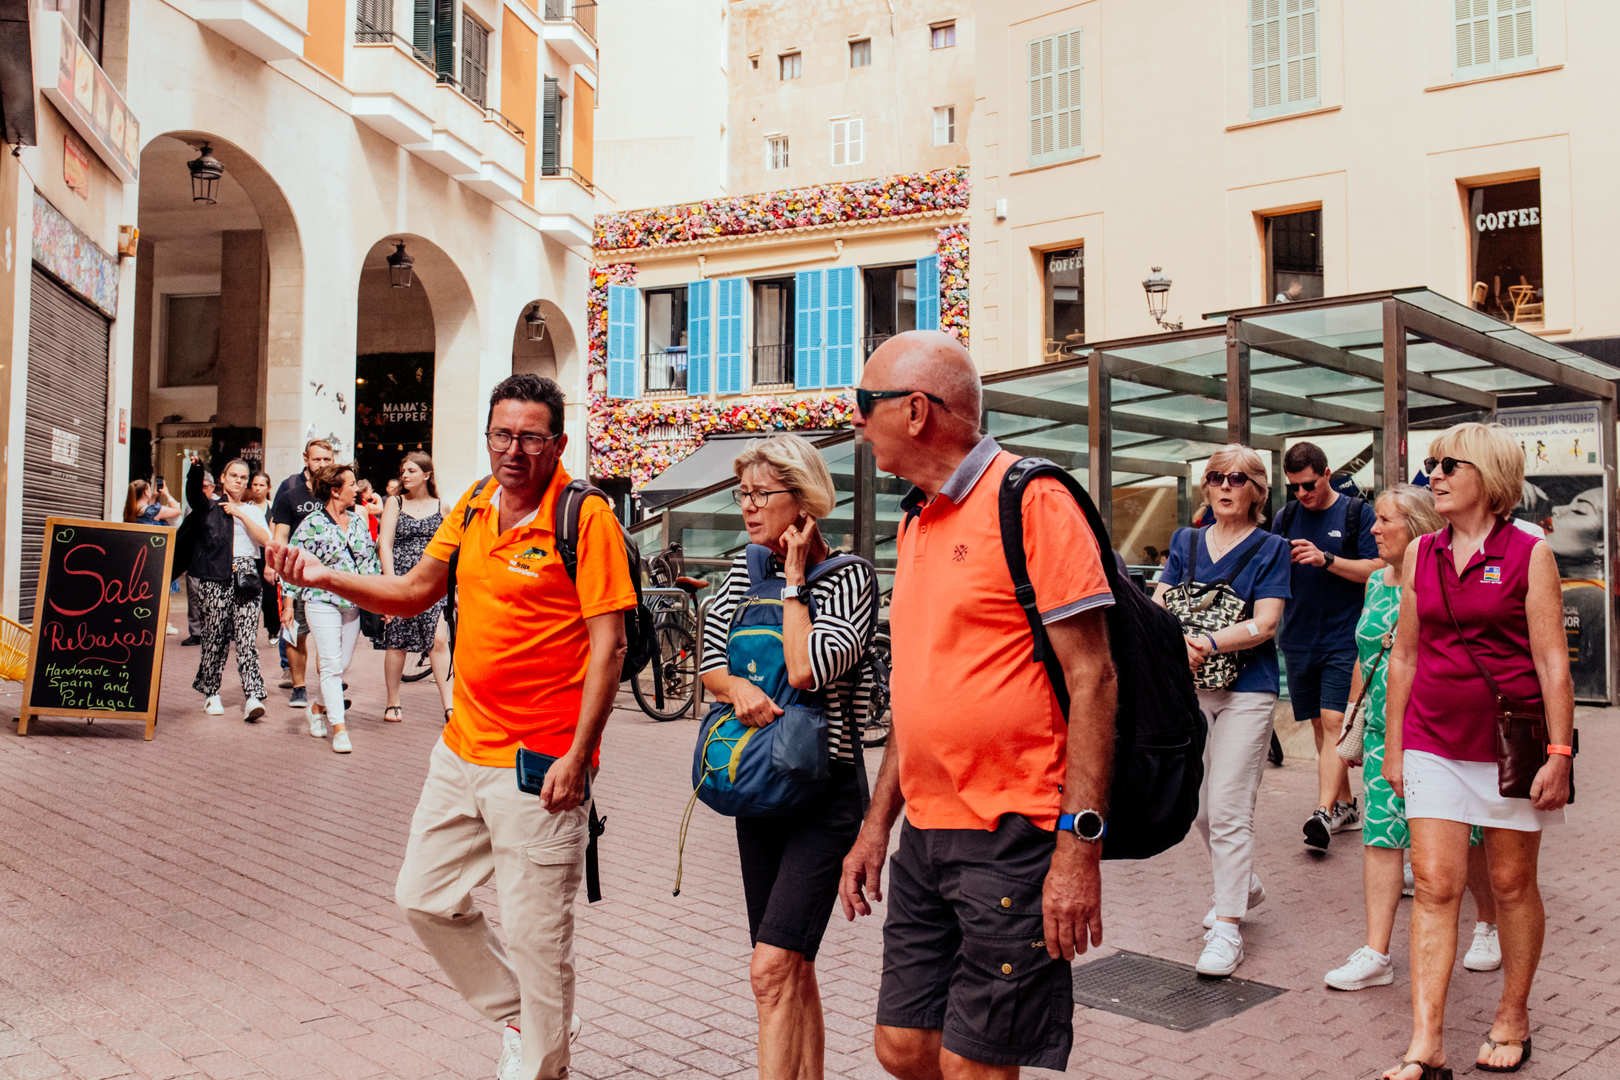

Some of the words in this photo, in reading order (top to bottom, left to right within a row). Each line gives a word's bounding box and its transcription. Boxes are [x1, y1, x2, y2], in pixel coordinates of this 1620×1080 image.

[1476, 207, 1540, 232] COFFEE
[383, 401, 428, 412] MAMA'S
[297, 501, 325, 512] s.Oli
[49, 543, 154, 617] Sale
[43, 619, 154, 665] Rebajas
[45, 663, 111, 677] Handmade
[119, 665, 130, 680] in
[48, 675, 93, 693] Spain
[103, 681, 129, 694] and
